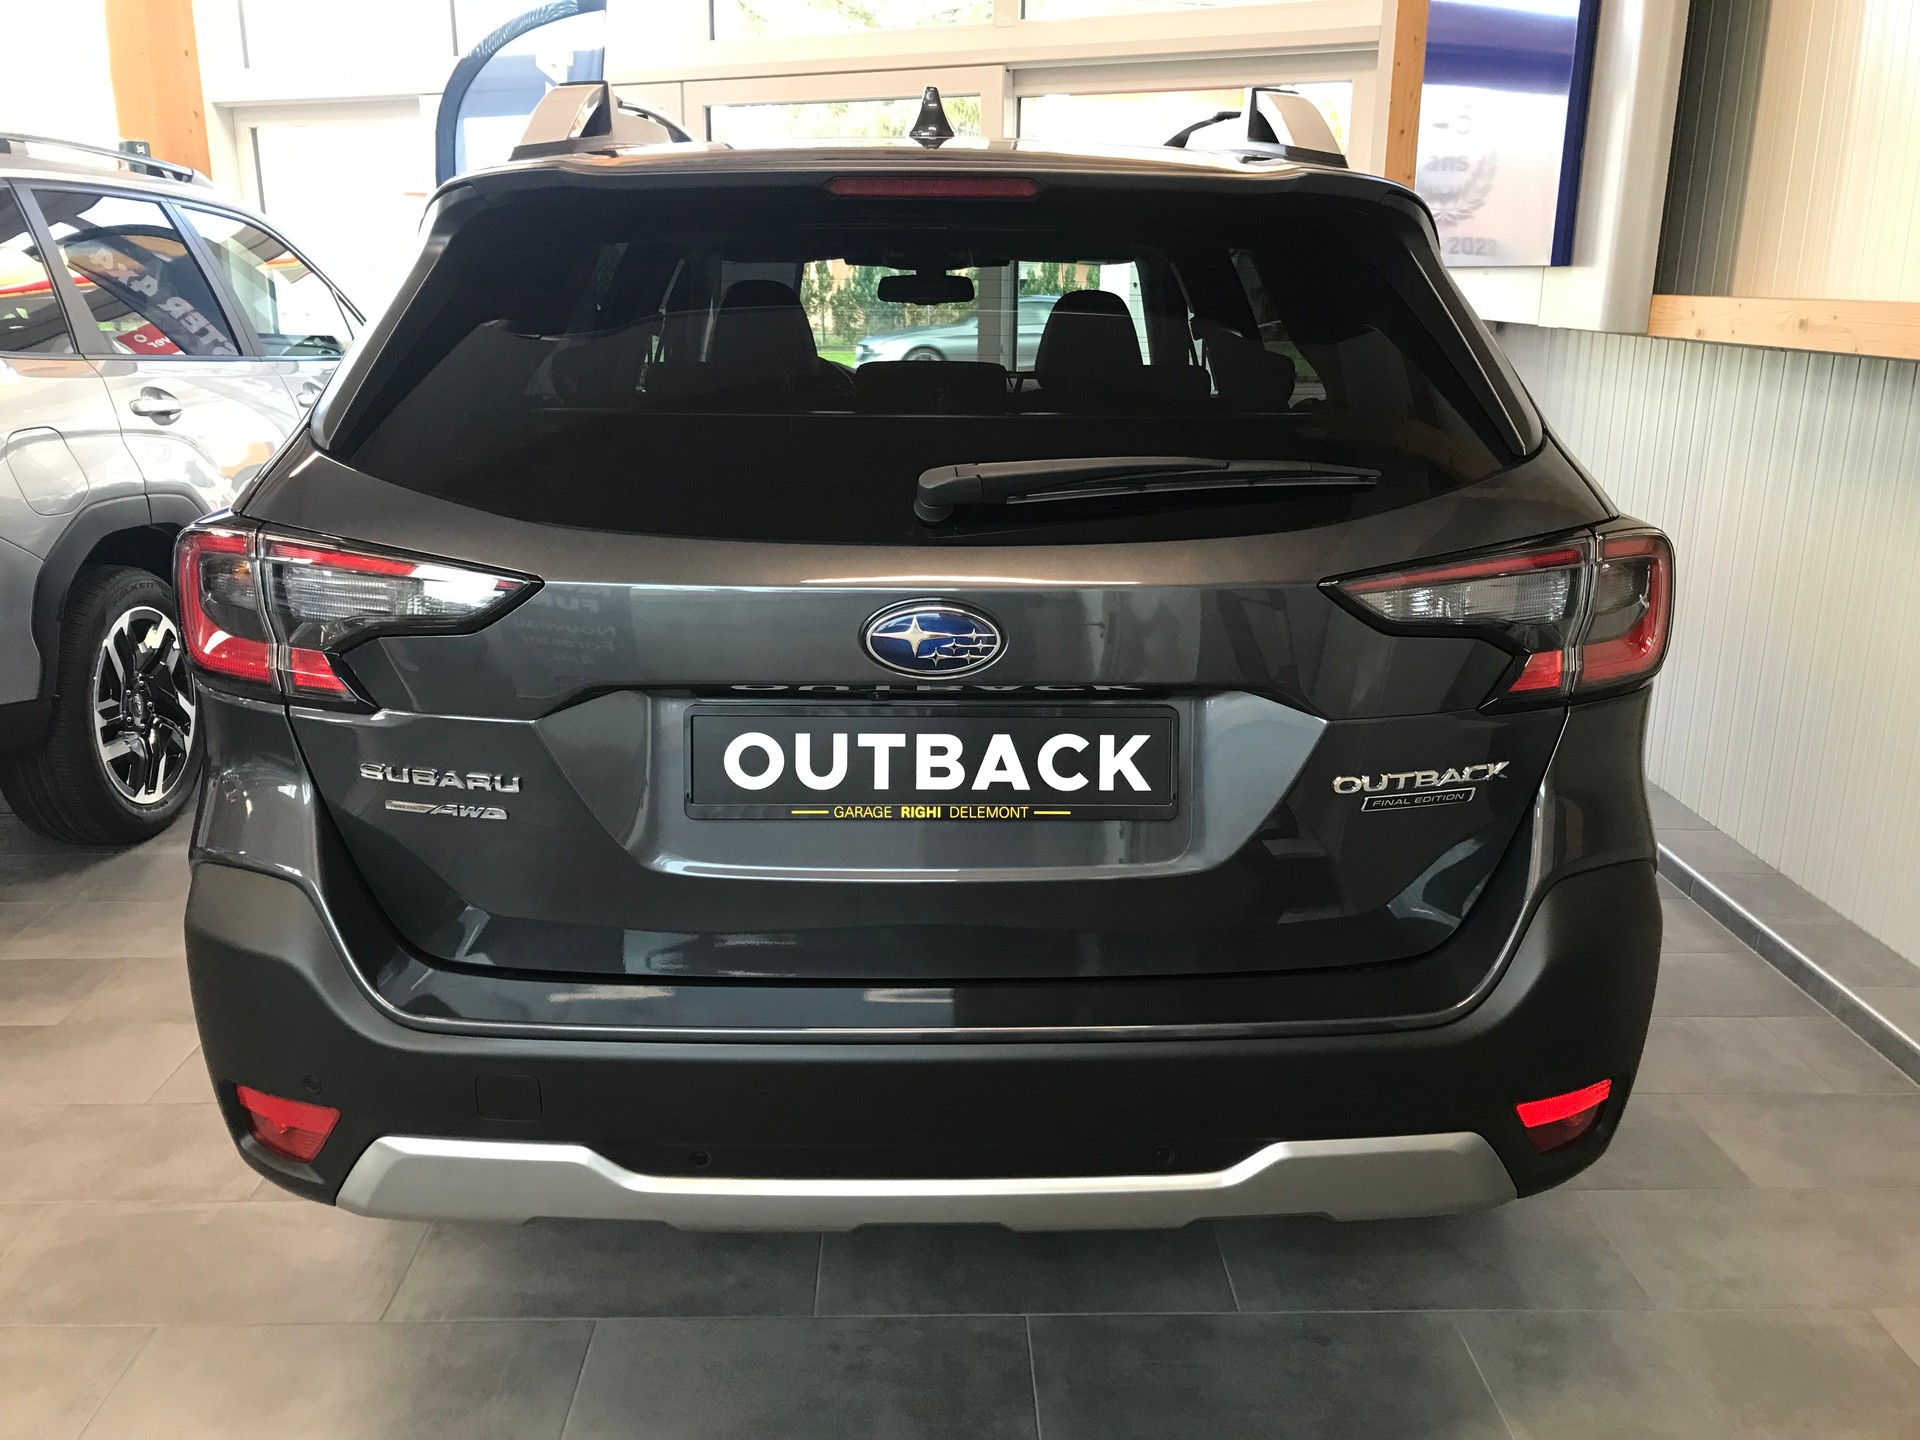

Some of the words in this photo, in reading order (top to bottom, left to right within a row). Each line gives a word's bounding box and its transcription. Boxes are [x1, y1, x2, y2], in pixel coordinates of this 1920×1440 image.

[723, 731, 1152, 792] OUTBACK
[359, 762, 523, 794] SUBARU
[1331, 760, 1510, 794] OUTBACK
[429, 803, 508, 821] AWD
[833, 805, 892, 819] GARAGE
[900, 805, 942, 819] RIGHI
[949, 805, 1029, 819] DELEMONT
[1372, 797, 1411, 807] FINAL
[1414, 793, 1465, 804] EDITION
